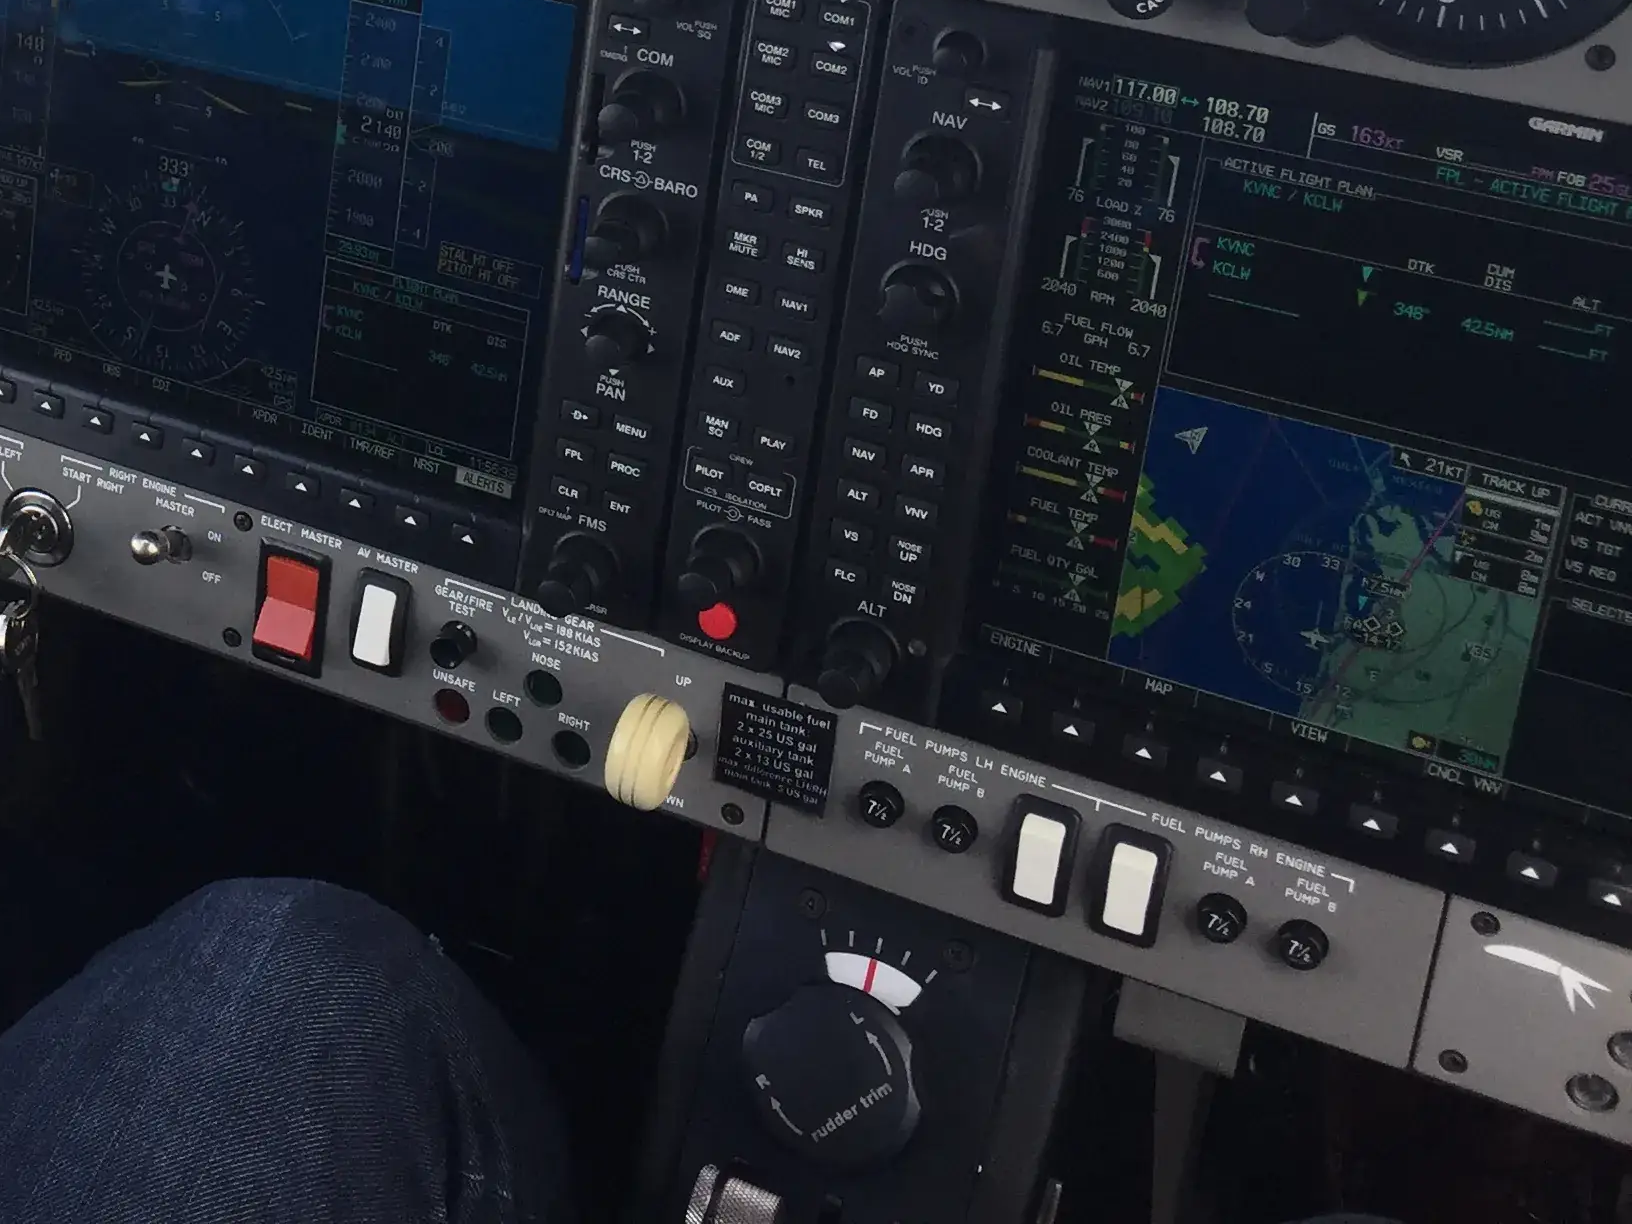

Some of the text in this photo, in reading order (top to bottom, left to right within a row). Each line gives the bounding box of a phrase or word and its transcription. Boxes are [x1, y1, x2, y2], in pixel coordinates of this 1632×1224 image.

[770, 6, 790, 18] MIC
[823, 11, 855, 27] COM1
[636, 48, 674, 67] COM
[757, 42, 790, 66] COM2 MIC
[815, 60, 848, 76] COM2
[1114, 78, 1177, 105] 117.00
[1206, 96, 1269, 124] 108.70
[931, 111, 968, 130] NAV
[1317, 122, 1336, 136] GS
[1202, 116, 1266, 144] 108.70
[1527, 116, 1605, 144] GARMIN
[746, 138, 772, 152] COM
[1436, 146, 1464, 162] VSR
[807, 158, 827, 172] TEL
[599, 164, 698, 199] CRS BARO
[1224, 157, 1373, 198] ACTIVE FLIGHT PLAN
[1095, 196, 1129, 213] LOAD
[1490, 179, 1620, 216] ACTIVE FLIGHT
[794, 204, 824, 219] SPKR
[729, 242, 759, 258] MUTE
[908, 240, 948, 261] HDG
[786, 255, 816, 271] SENS
[597, 284, 651, 310] RANGE
[725, 283, 750, 298] DME
[1090, 291, 1116, 307] RPM
[781, 298, 809, 313] NAV1
[1130, 298, 1168, 318] 2040
[1064, 313, 1096, 331] FUEL
[719, 330, 742, 343] ADF
[1083, 332, 1109, 349] GPH
[773, 344, 802, 360] NAV2
[1059, 352, 1083, 368] OIL
[712, 375, 735, 389] AUX
[595, 382, 626, 401] PAN
[300, 422, 335, 441] IDENT
[615, 422, 648, 439] MENU
[705, 415, 730, 430] MAN
[915, 422, 943, 438] HDG
[759, 436, 787, 451] PLAY
[564, 448, 584, 462] FPL
[851, 446, 876, 462] NAV
[1027, 445, 1082, 470] COOLANT
[610, 460, 641, 478] PROC
[694, 464, 725, 480] PILOT
[909, 464, 935, 479] APR
[62, 466, 125, 495] START RIGHT
[109, 467, 177, 498] RIGHT ENGINE
[463, 471, 505, 494] ALERTS
[1482, 473, 1527, 494] TRACK
[557, 485, 579, 499] CLR
[847, 488, 869, 501] ALT
[155, 497, 195, 517] MASTER
[609, 501, 632, 515] ENT
[696, 499, 723, 514] PILOT
[904, 504, 928, 520] VNV
[1029, 496, 1061, 515] FUEL
[578, 514, 608, 532] FMS
[747, 514, 772, 529] PASS
[300, 527, 343, 550] MASTER
[376, 552, 421, 573] MASTER
[1010, 544, 1042, 563] FUEL
[834, 568, 856, 583] FLC
[448, 600, 476, 618] TEST
[857, 600, 888, 618] ALT
[989, 631, 1043, 658] ENGINE
[531, 652, 561, 670] NOSE
[433, 669, 476, 692] UNSAFE
[675, 674, 692, 687] UP
[492, 689, 521, 708] LEFT
[558, 712, 591, 731] RIGHT
[745, 712, 776, 728] main
[762, 703, 831, 730] usable fuel
[1290, 721, 1329, 744] VIEW
[776, 732, 817, 754] US gal
[874, 740, 905, 760] FUEL
[773, 759, 791, 773] US
[864, 750, 896, 768] PUMP
[885, 726, 1047, 789] FUEL PUMPS ENGINE
[948, 764, 979, 784] FUEL
[937, 774, 971, 793] PUMP
[1151, 812, 1326, 879] FUEL PUMPS ENGINE
[1203, 861, 1239, 880] PUMP
[1215, 852, 1248, 872] FUEL
[1296, 877, 1330, 898] FUEL
[1284, 887, 1321, 907] PUMP
[811, 1082, 893, 1143] rudder trim
